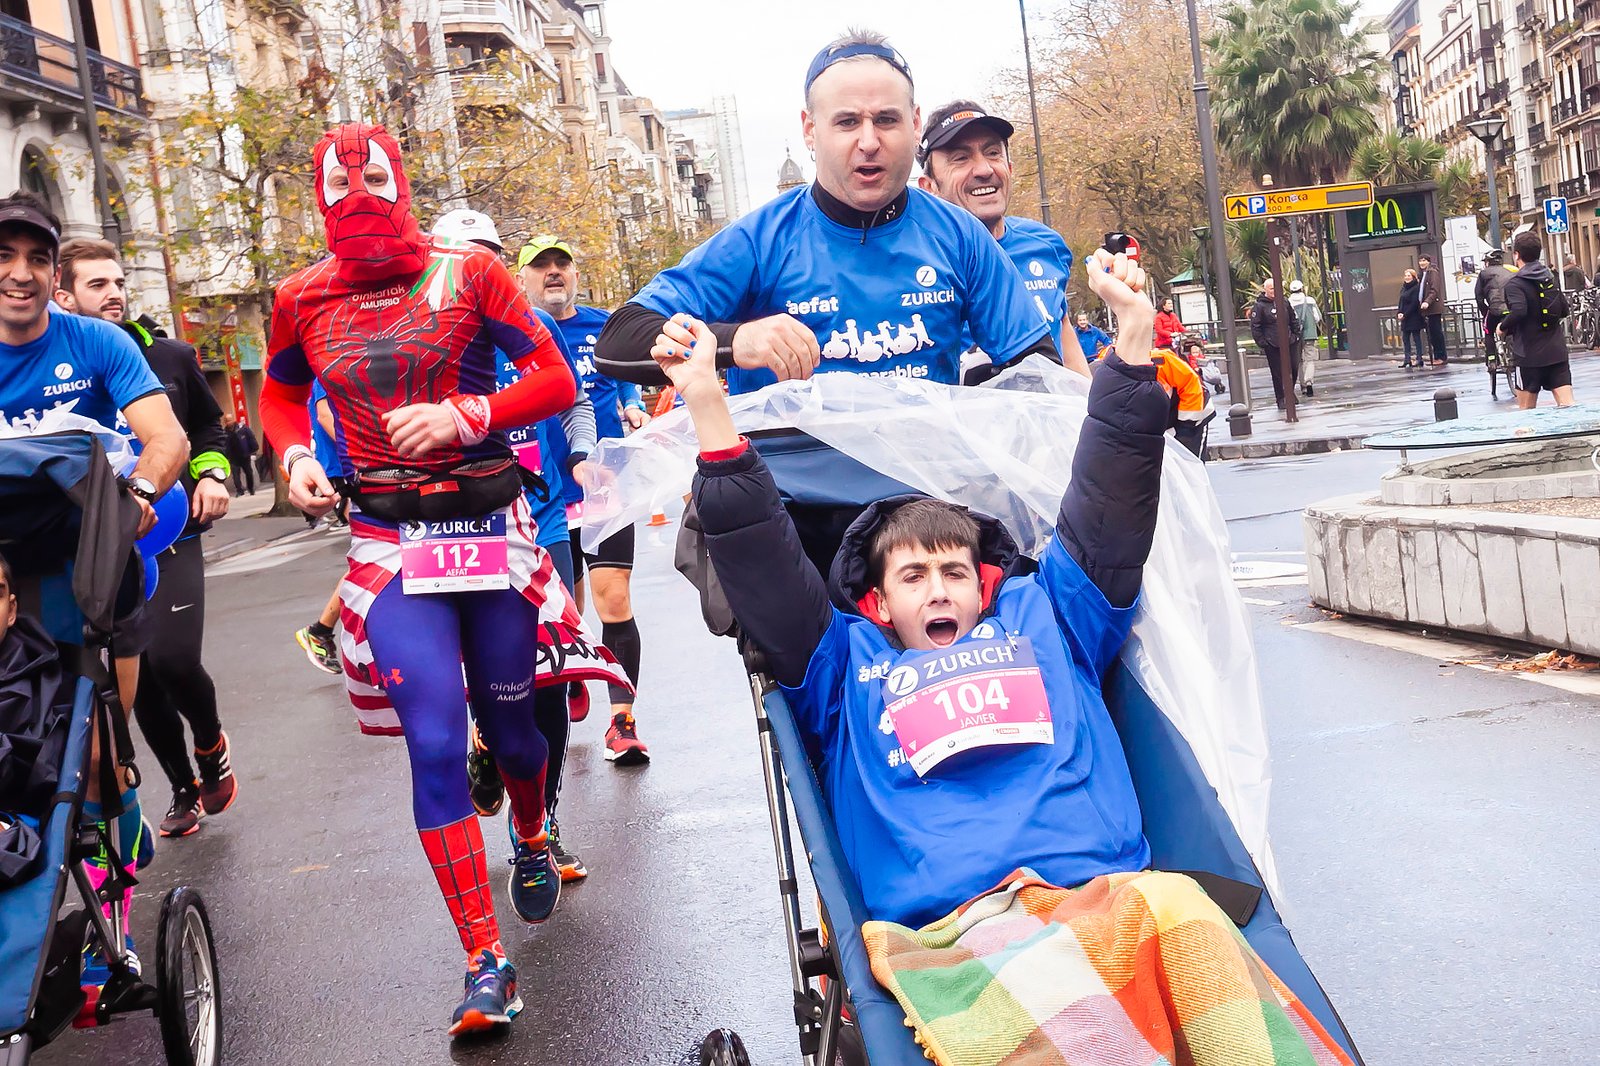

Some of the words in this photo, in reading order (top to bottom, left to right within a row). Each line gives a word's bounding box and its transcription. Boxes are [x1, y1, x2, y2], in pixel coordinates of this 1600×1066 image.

[1025, 279, 1057, 291] ZURICH
[359, 297, 400, 310] AMURRIO
[786, 296, 839, 315] aefat
[901, 290, 955, 307] ZURICH
[43, 378, 92, 397] ZURICH
[431, 519, 491, 535] ZURICH
[431, 543, 481, 569] 112
[445, 567, 468, 577] AEFAT
[923, 645, 1015, 680] ZURICH
[933, 678, 1010, 721] 104
[960, 712, 998, 730] JAVIER
